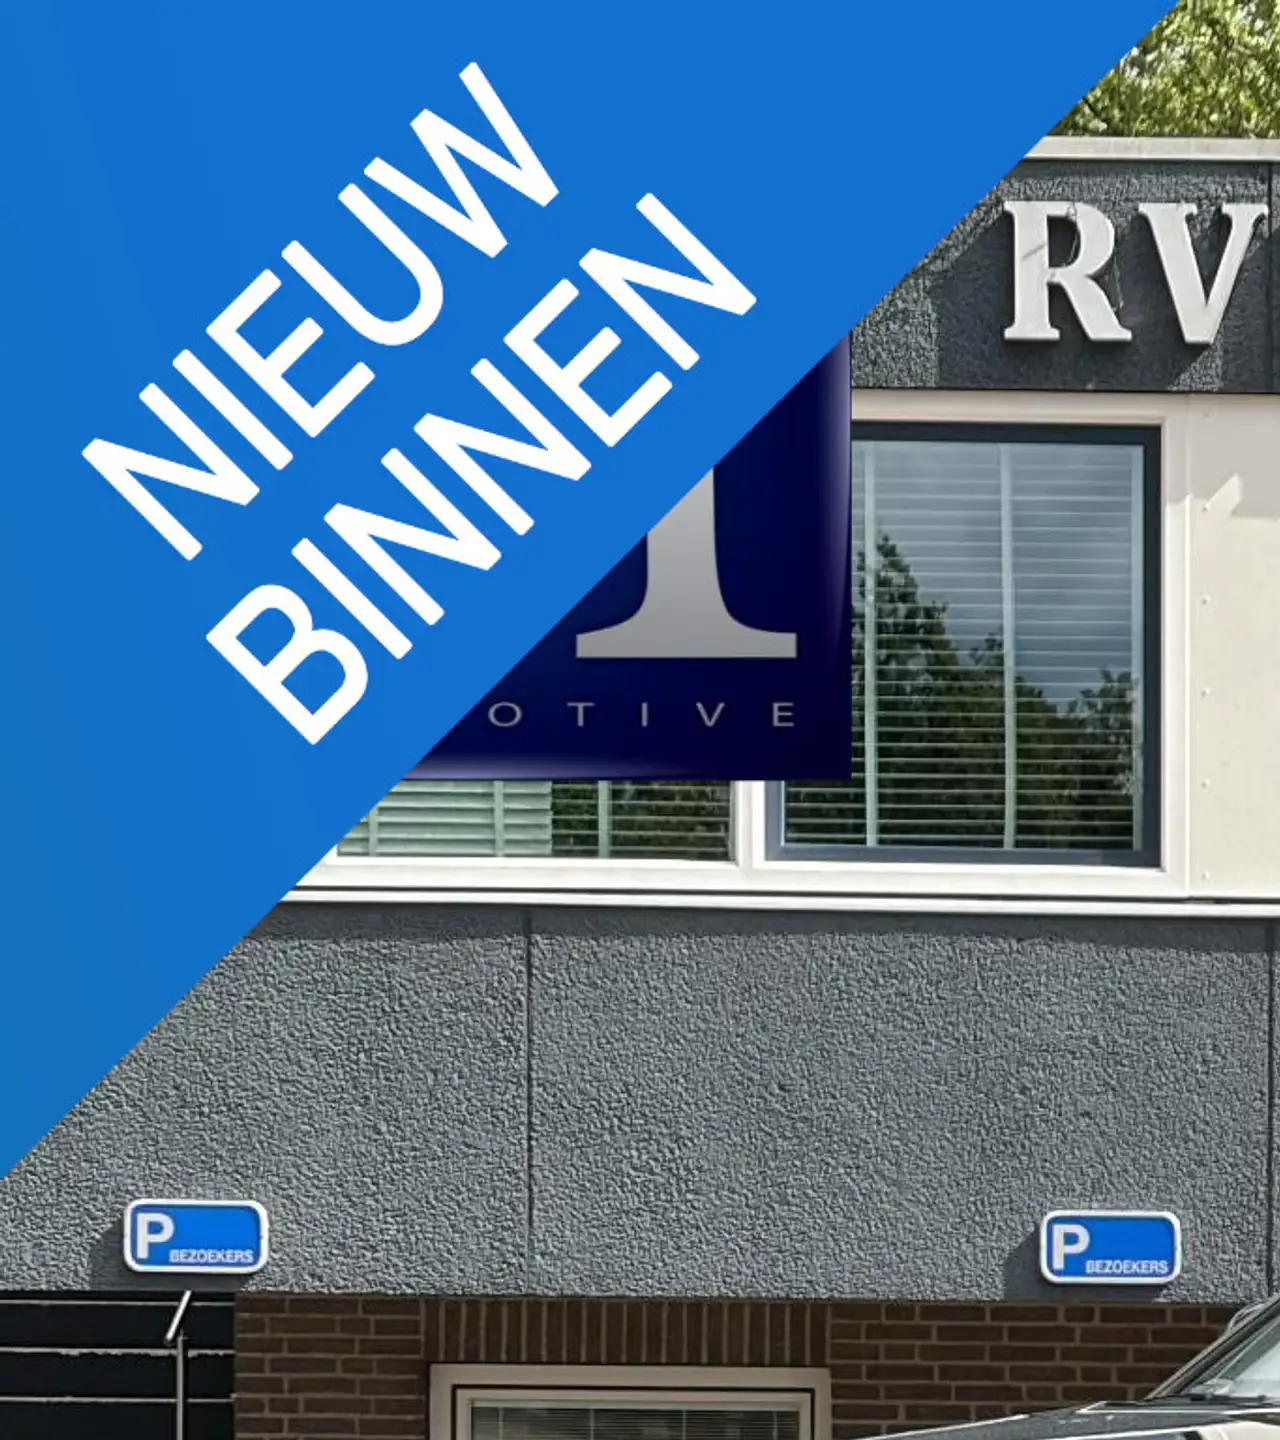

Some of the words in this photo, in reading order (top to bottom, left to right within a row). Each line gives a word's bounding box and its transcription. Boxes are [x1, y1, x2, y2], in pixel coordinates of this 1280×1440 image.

[136, 1213, 175, 1260] P
[1052, 1224, 1090, 1270] P
[169, 1249, 253, 1263] BEZOEKERS
[1086, 1260, 1169, 1274] BEZOEKERS
